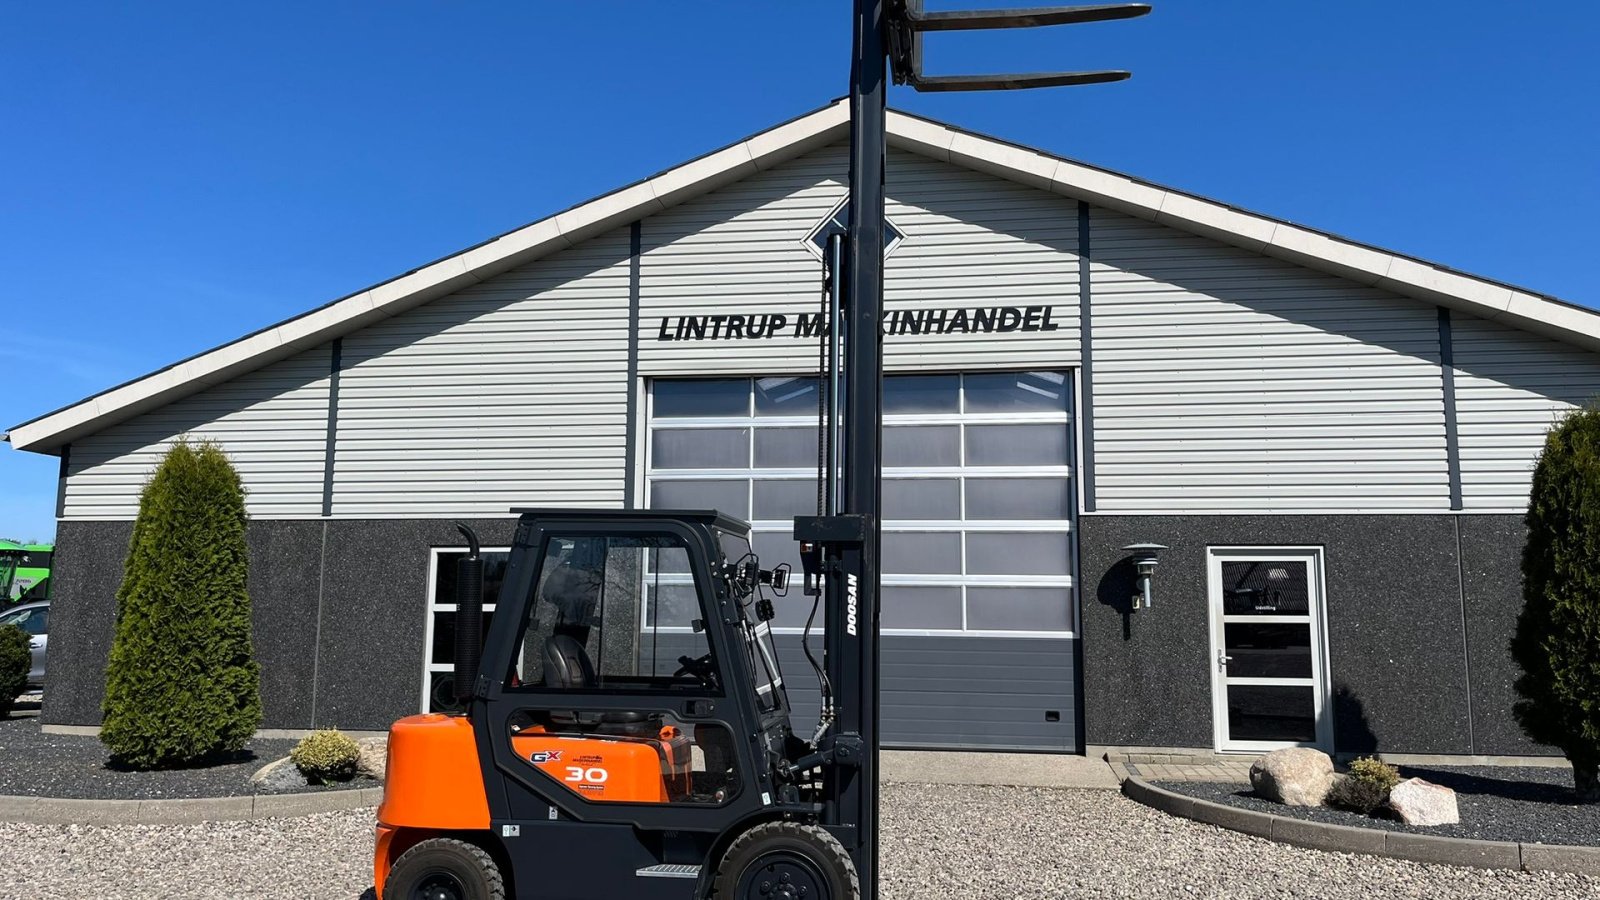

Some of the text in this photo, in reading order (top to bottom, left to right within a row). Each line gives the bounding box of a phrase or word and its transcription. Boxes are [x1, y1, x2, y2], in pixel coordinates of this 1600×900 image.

[658, 306, 1059, 341] LINTRUP MINHANDEL
[847, 573, 857, 636] DOOSAN
[530, 750, 562, 764] GX
[565, 766, 608, 783] 30
